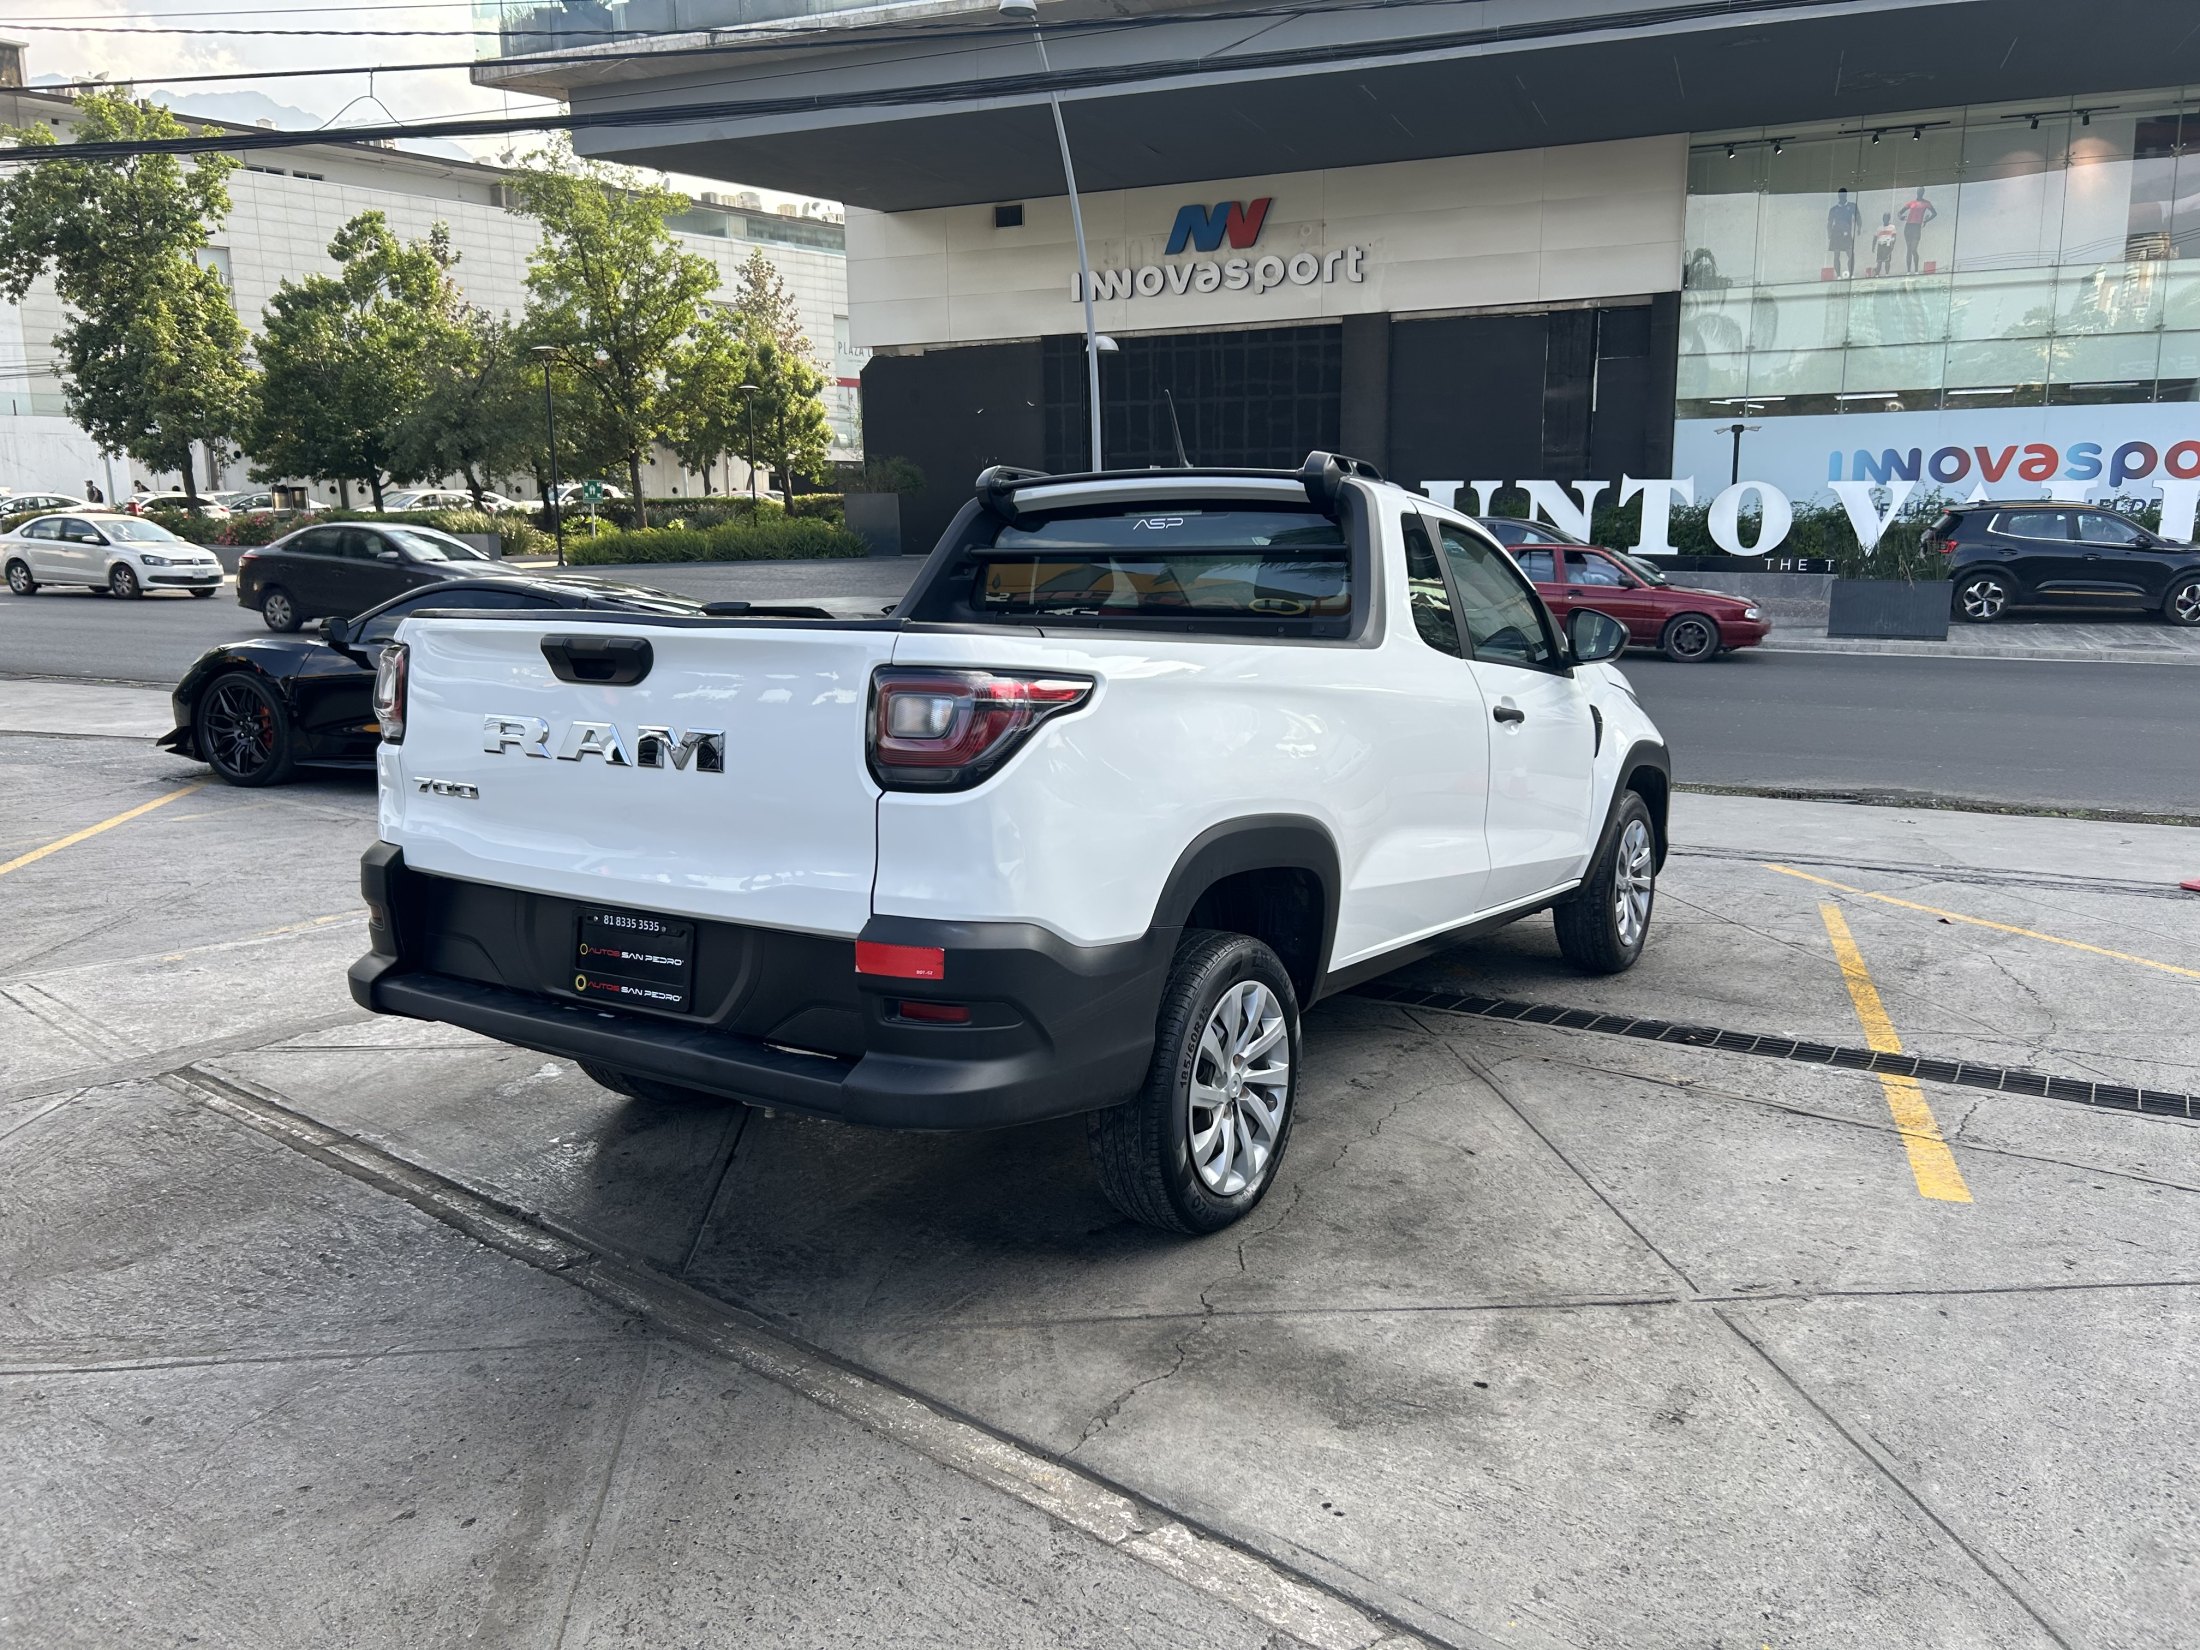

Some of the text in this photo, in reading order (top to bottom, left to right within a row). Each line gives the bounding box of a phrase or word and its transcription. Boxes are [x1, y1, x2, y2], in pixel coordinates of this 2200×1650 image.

[1132, 517, 1184, 530] ASP
[1764, 558, 1808, 571] THE
[483, 713, 727, 773] RAM
[412, 776, 480, 800] 700
[603, 914, 660, 932] 81 8335 3535
[588, 947, 683, 966] AUTOS SAN PEDRO
[587, 981, 681, 1002] AUTOS SAN PEDRO
